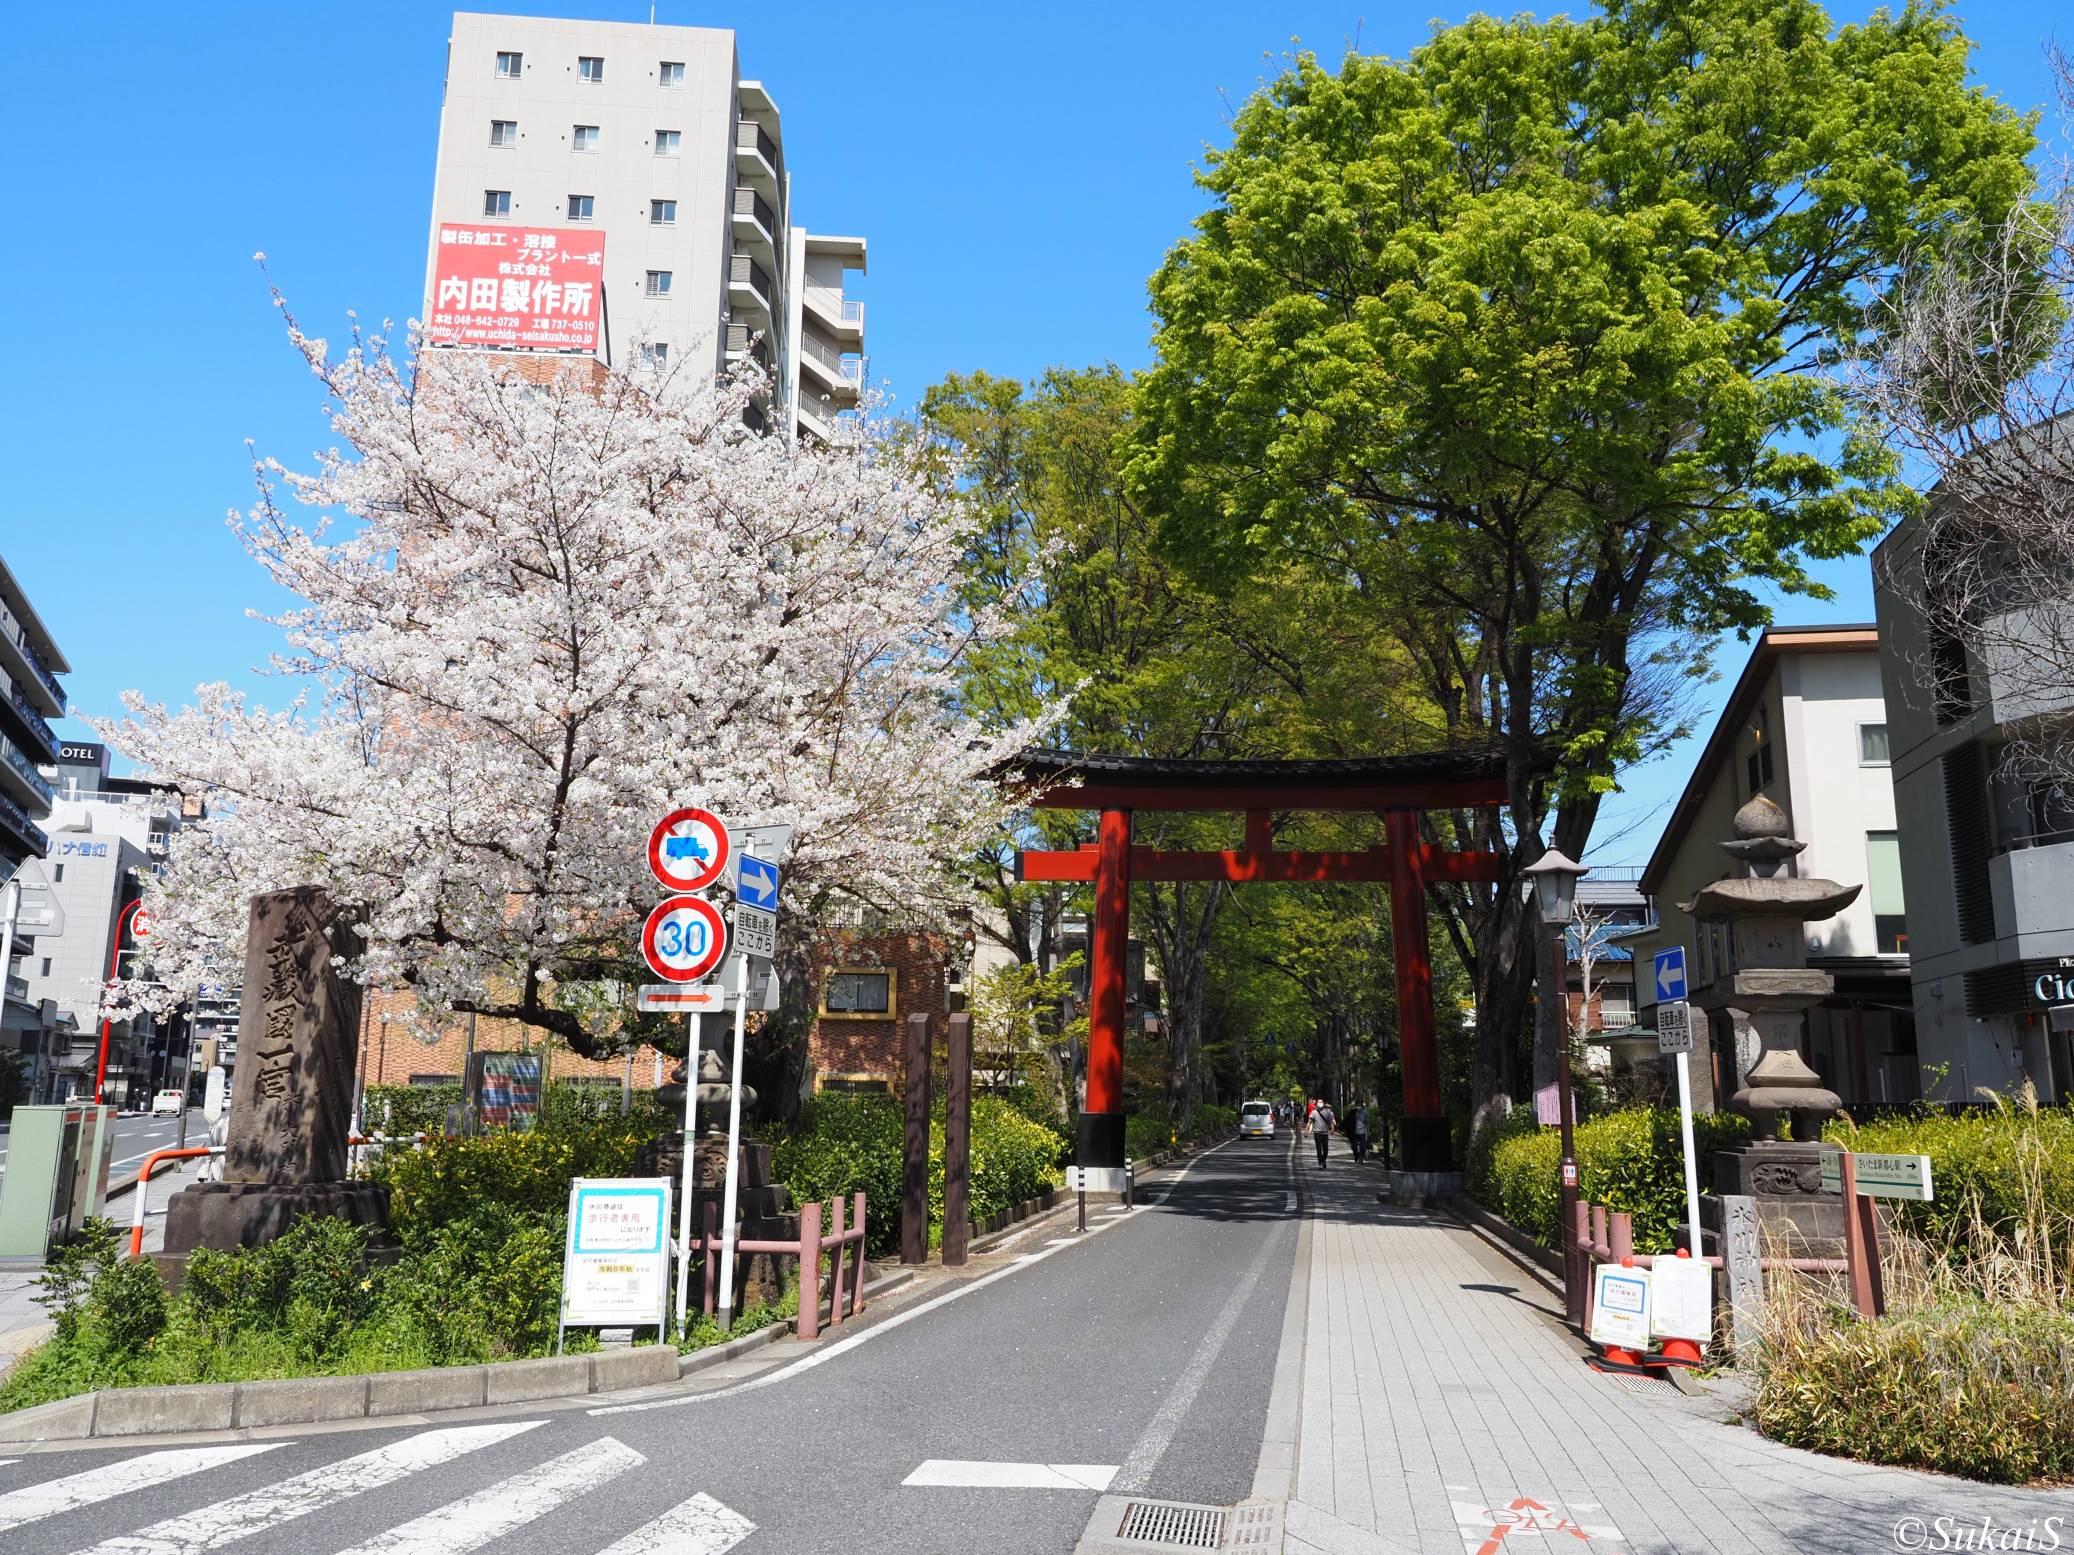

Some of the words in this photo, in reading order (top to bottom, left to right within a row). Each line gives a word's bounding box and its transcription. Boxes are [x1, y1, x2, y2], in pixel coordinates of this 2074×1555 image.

[498, 262, 552, 276] 株式会社
[438, 275, 593, 316] 内田製作所
[435, 313, 452, 325] 本社
[454, 314, 520, 327] 048-642-0729
[551, 319, 595, 331] 737-0510
[60, 747, 95, 760] OTEL
[739, 911, 774, 935] 自転車を除く
[662, 921, 706, 957] 30
[737, 931, 772, 952] ここから
[1660, 1009, 1688, 1027] 自転車を除く
[1661, 1030, 1689, 1047] ここから
[1732, 1206, 1758, 1298] 氷川神社
